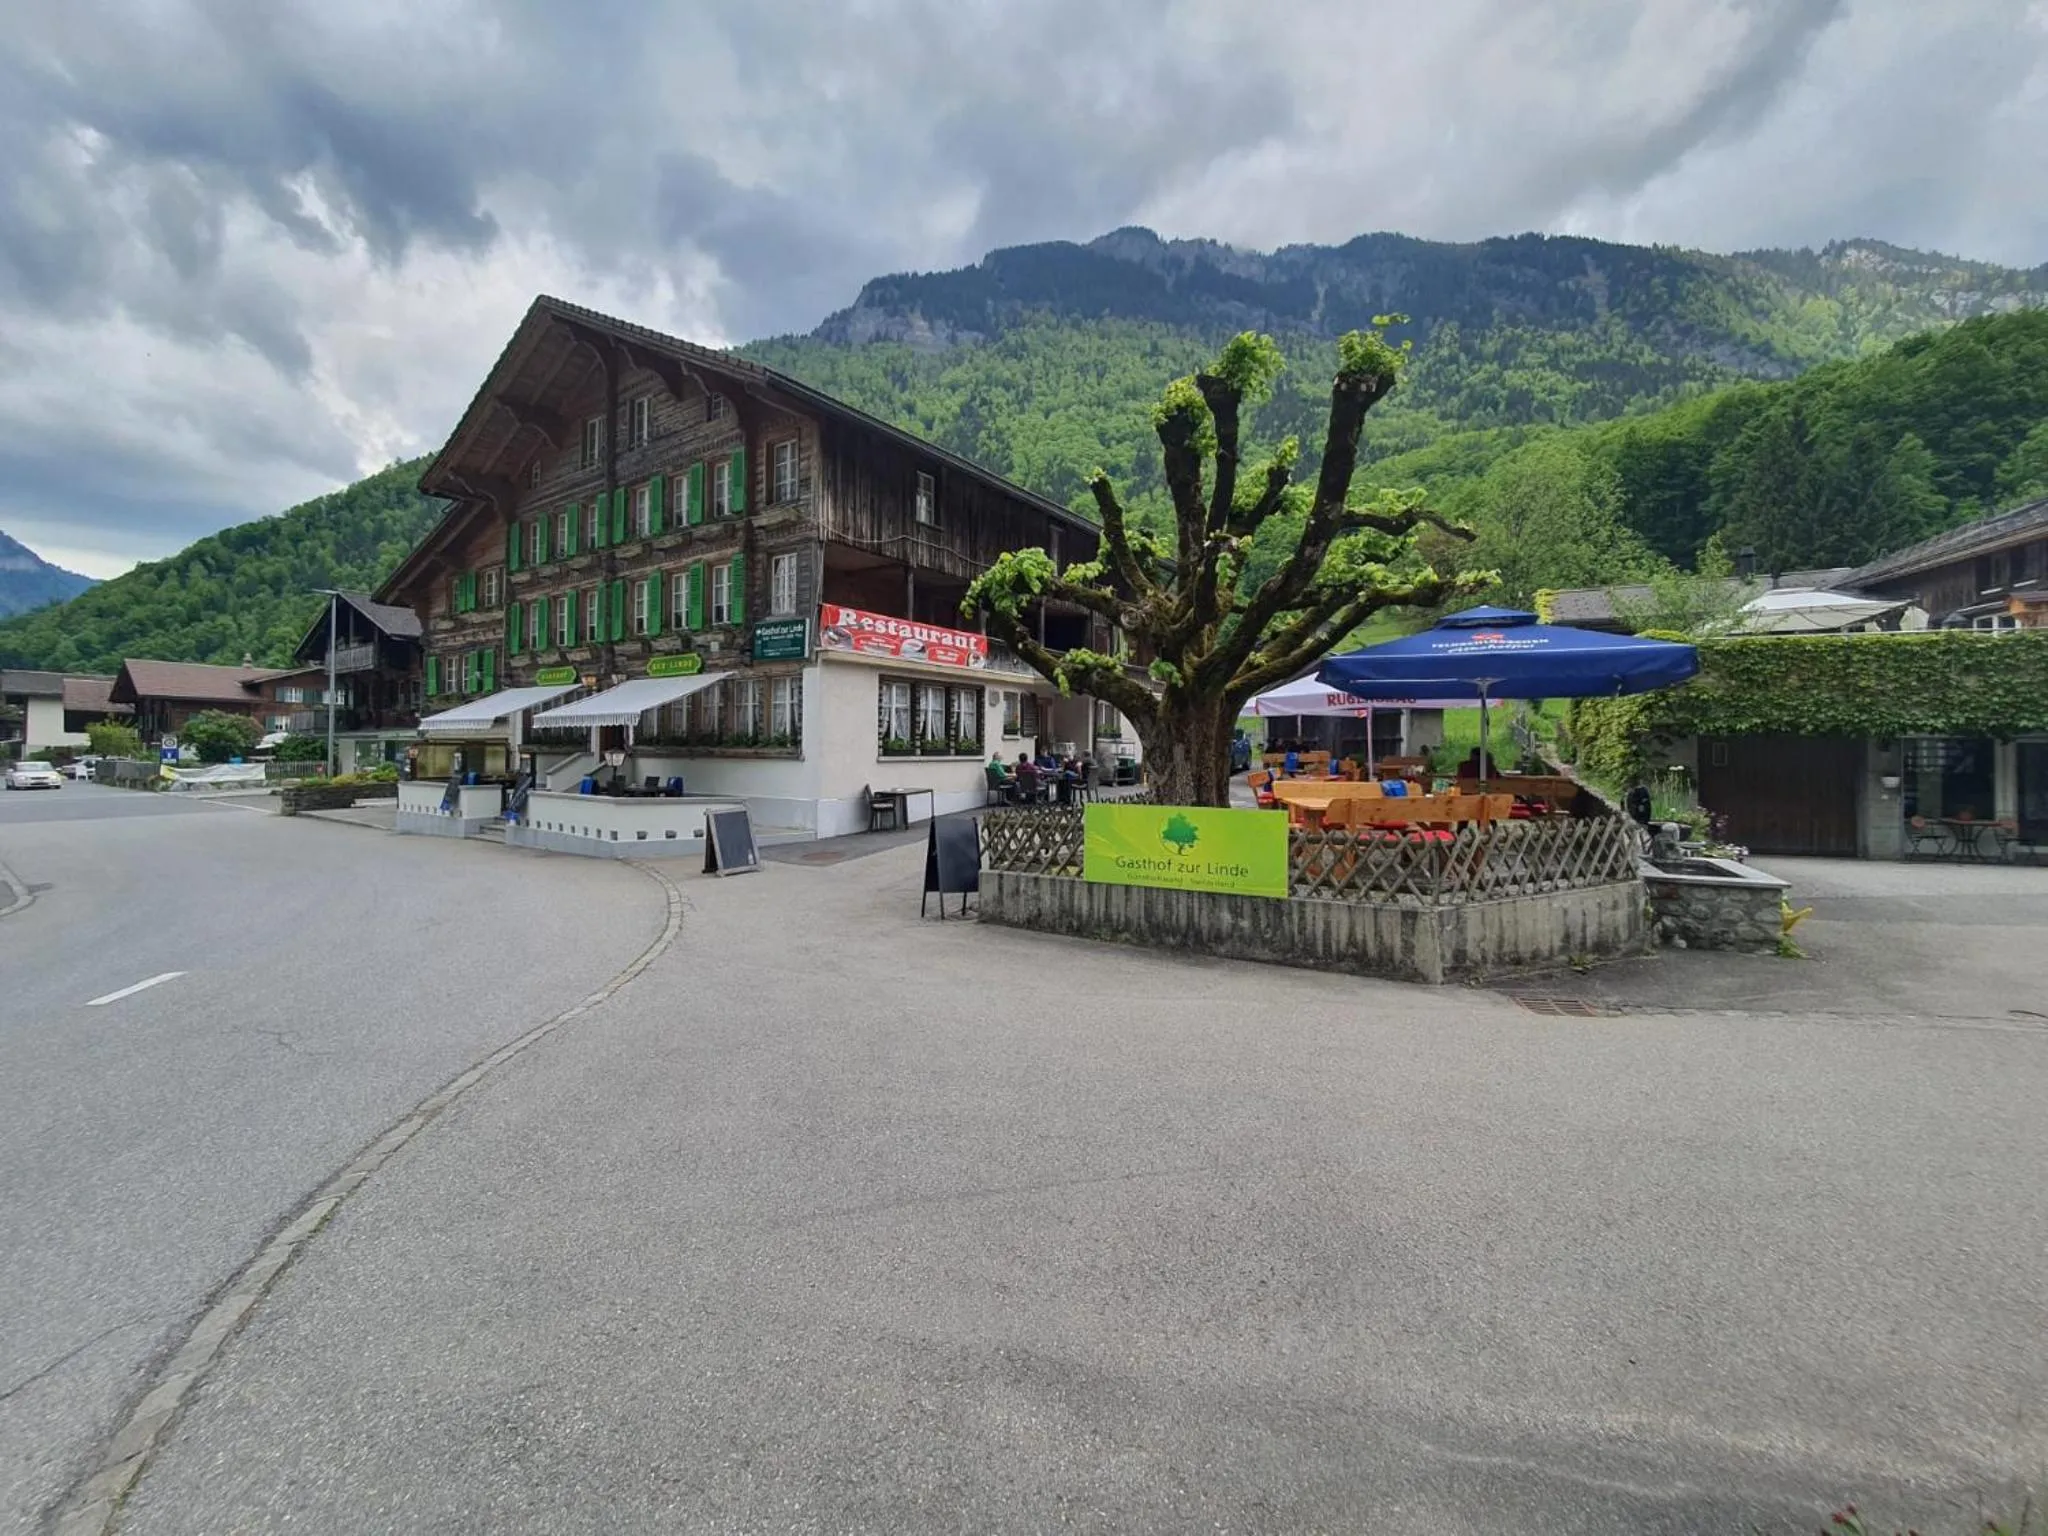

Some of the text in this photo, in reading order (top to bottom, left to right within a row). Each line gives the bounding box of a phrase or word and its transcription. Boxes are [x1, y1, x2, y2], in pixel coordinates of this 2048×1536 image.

[838, 608, 977, 649] Restaurant
[1115, 856, 1249, 878] Gasthof zur Linde
